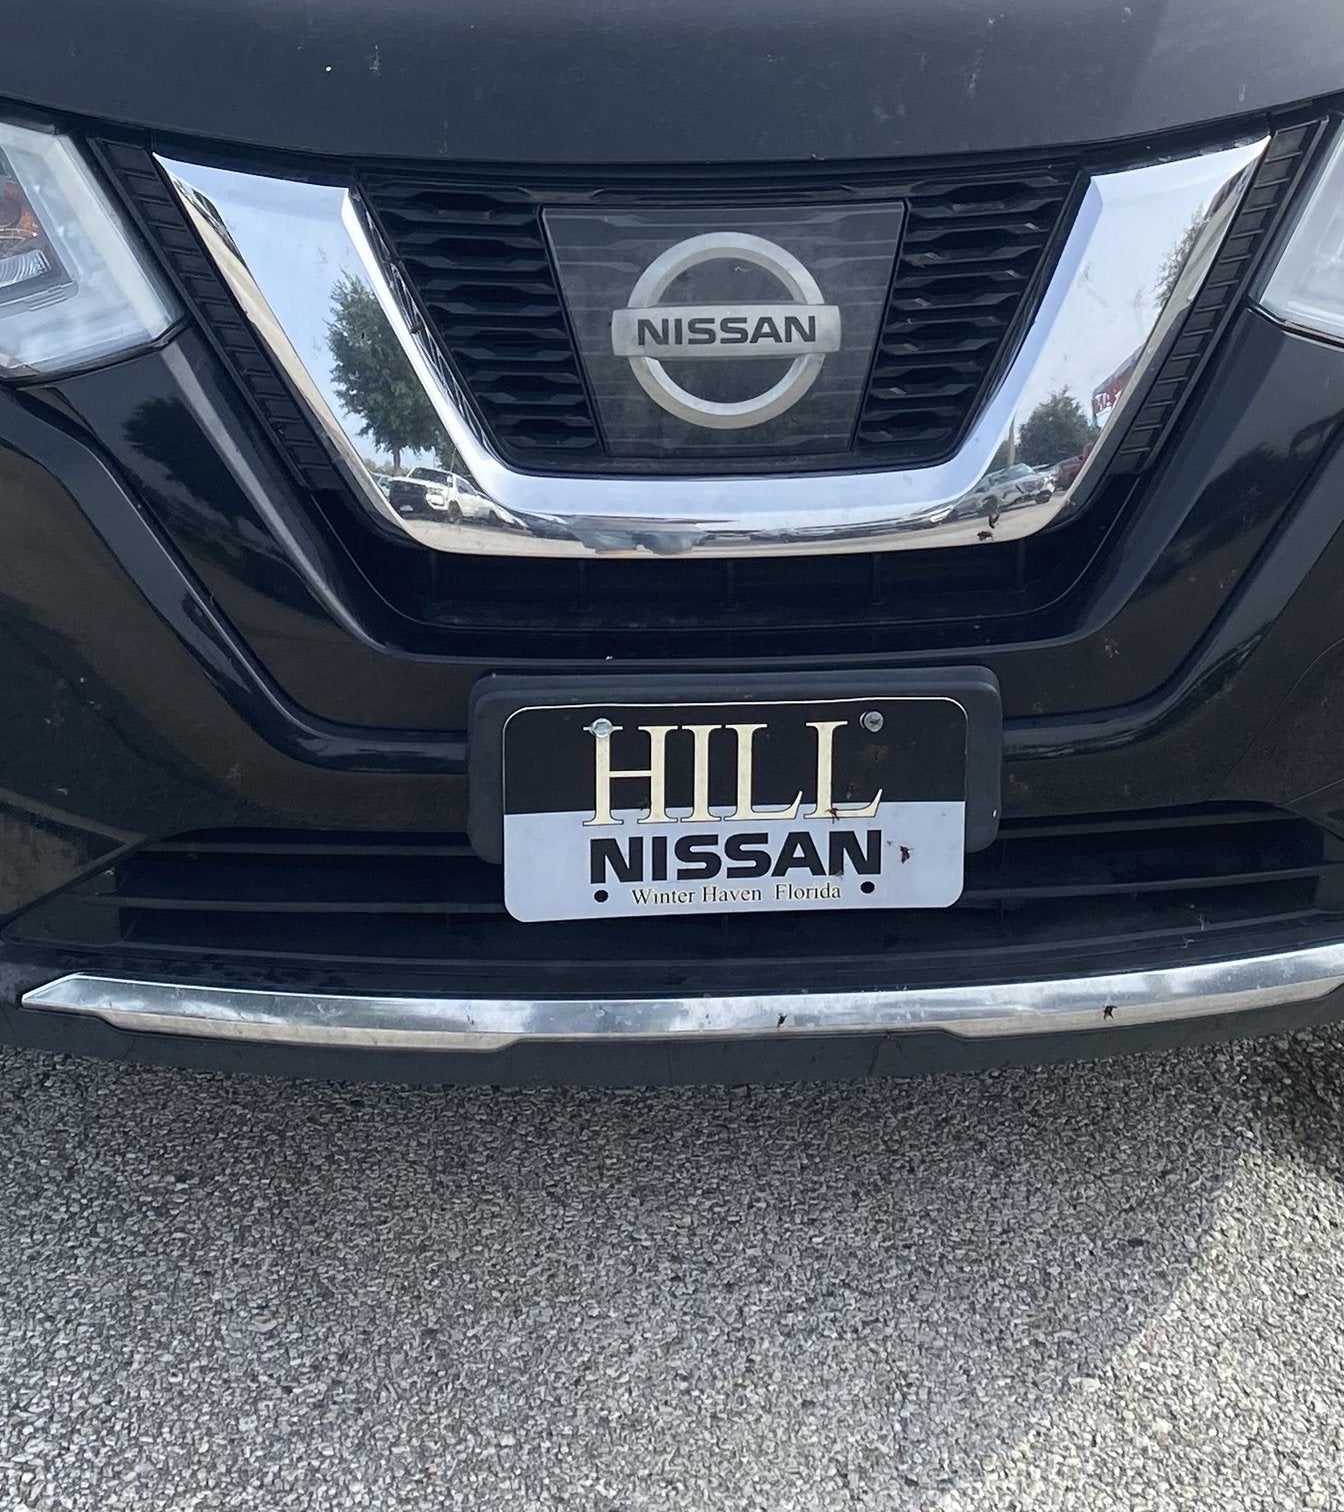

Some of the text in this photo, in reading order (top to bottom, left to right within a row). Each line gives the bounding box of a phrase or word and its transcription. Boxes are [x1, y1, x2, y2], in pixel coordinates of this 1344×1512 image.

[637, 315, 816, 346] NISSAN
[582, 720, 883, 827] HILL
[590, 829, 883, 884] NISSAN
[631, 883, 841, 904] Winter Haven Florida
